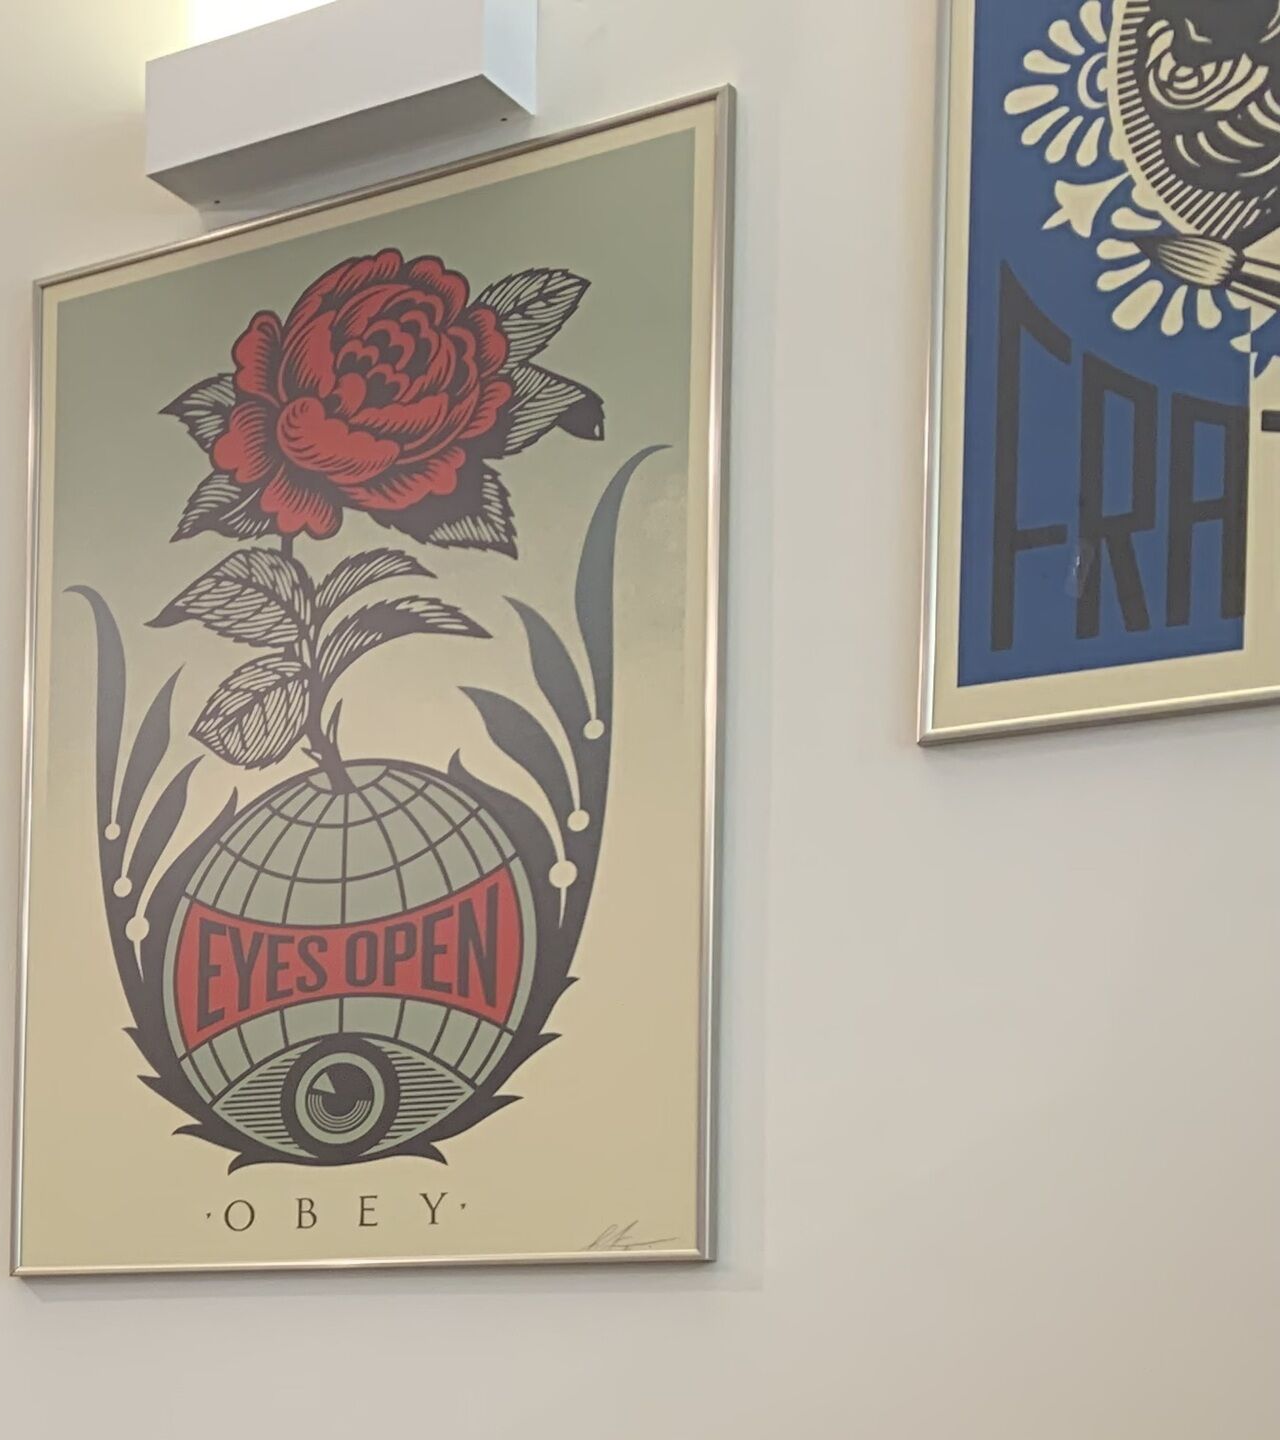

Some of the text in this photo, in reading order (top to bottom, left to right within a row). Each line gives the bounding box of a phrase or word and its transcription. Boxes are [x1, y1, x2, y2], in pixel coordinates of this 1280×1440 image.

[990, 259, 1280, 652] FRA
[197, 882, 500, 1033] EYES OPEN
